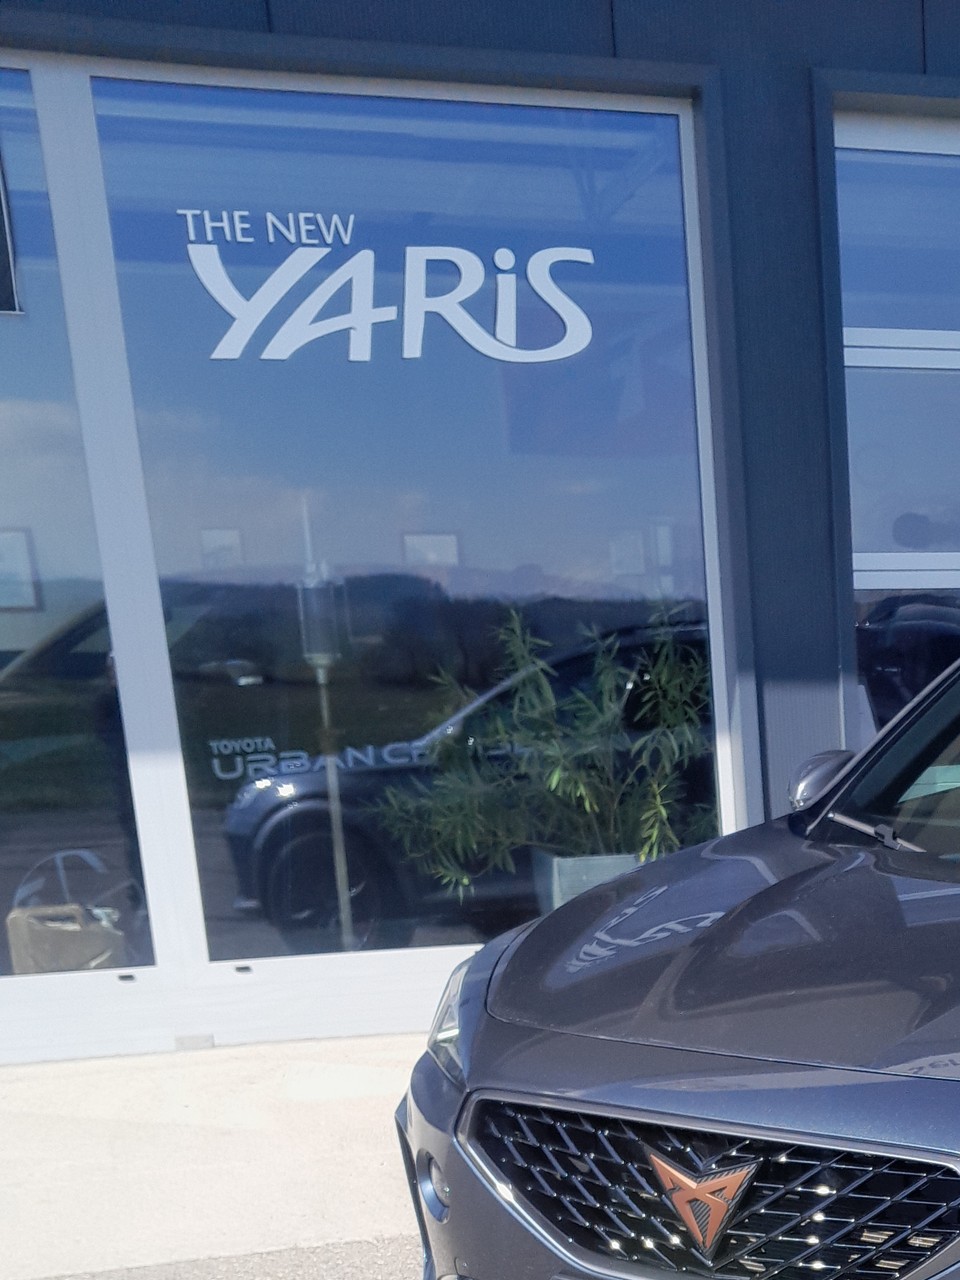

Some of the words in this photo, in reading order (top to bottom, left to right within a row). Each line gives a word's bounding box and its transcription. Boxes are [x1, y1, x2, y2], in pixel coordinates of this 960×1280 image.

[177, 209, 254, 243] THE
[265, 212, 355, 245] NEW
[208, 737, 276, 755] TOYOTA
[212, 745, 376, 780] URBAN
